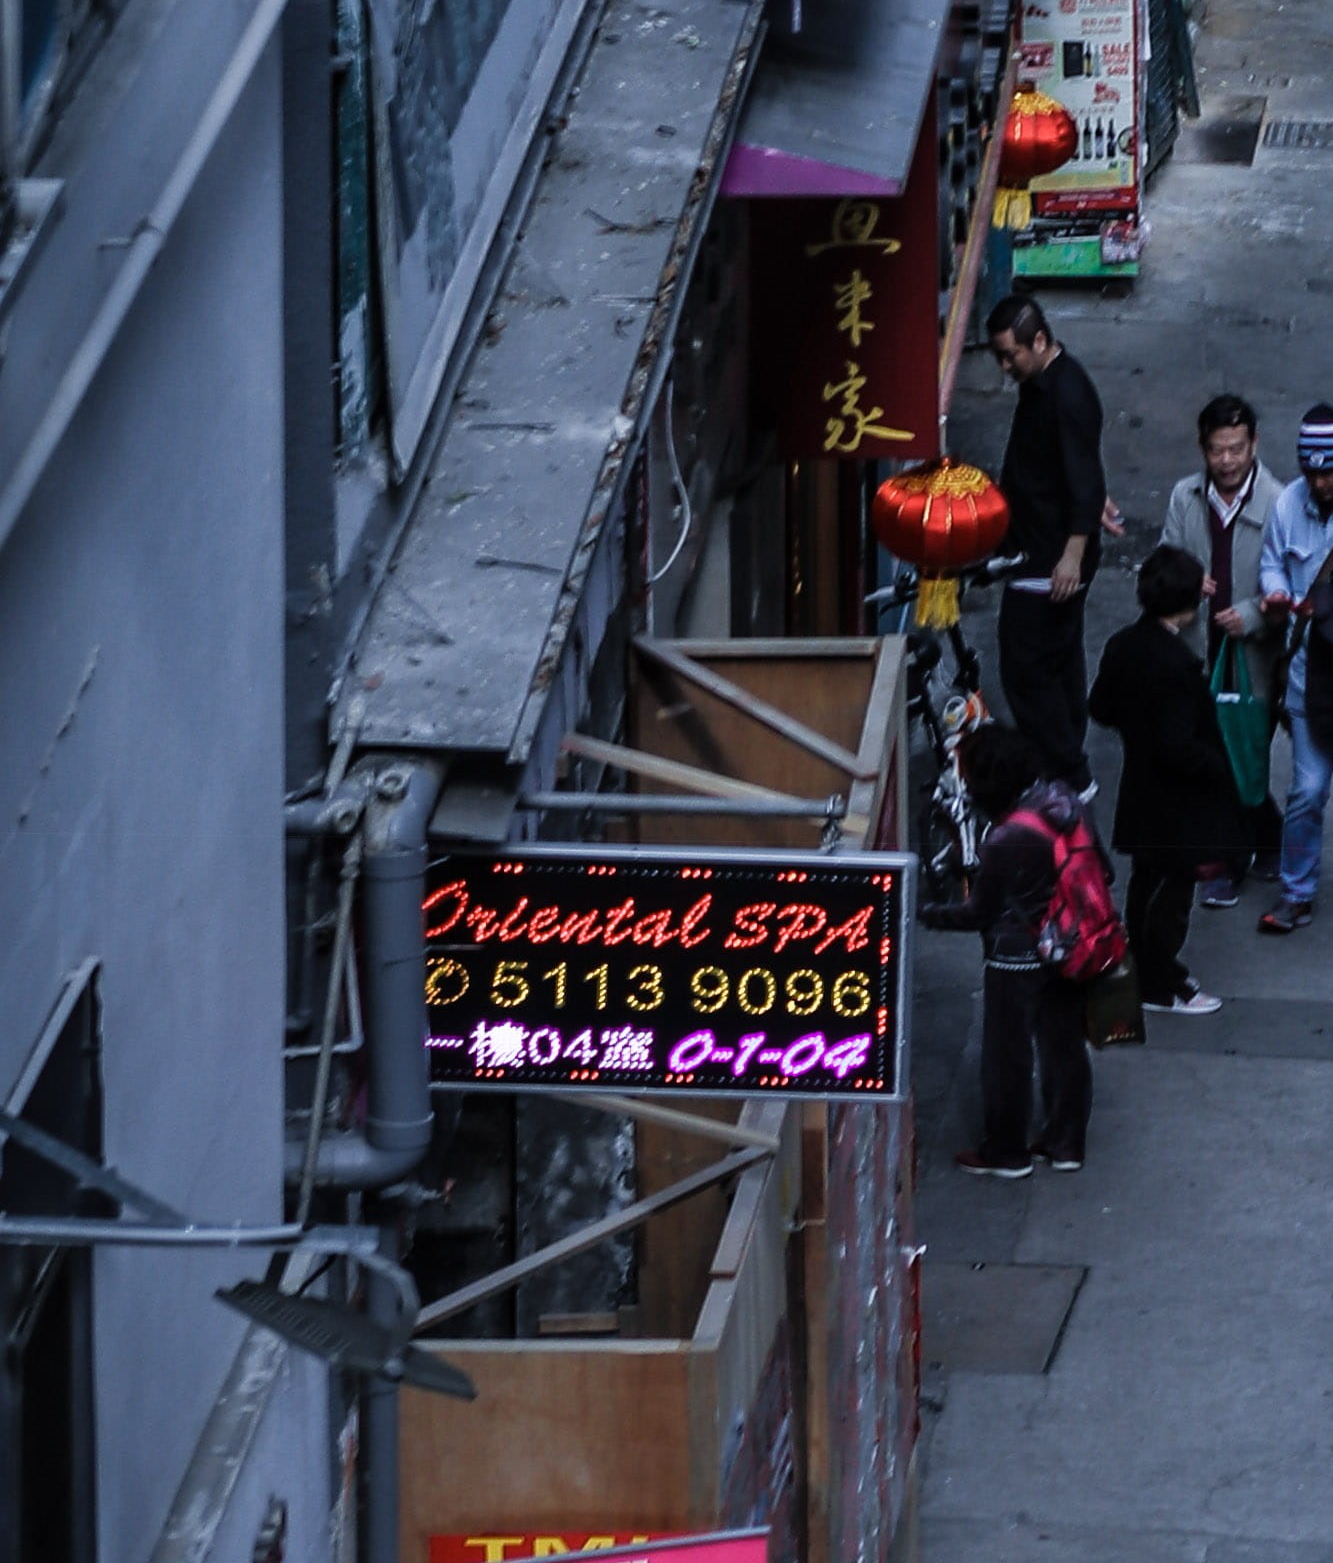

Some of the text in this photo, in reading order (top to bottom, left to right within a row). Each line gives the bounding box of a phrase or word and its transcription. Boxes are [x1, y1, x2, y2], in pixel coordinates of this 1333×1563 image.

[421, 878, 875, 955] Oriental SPA
[490, 959, 872, 1018] 5113 9096
